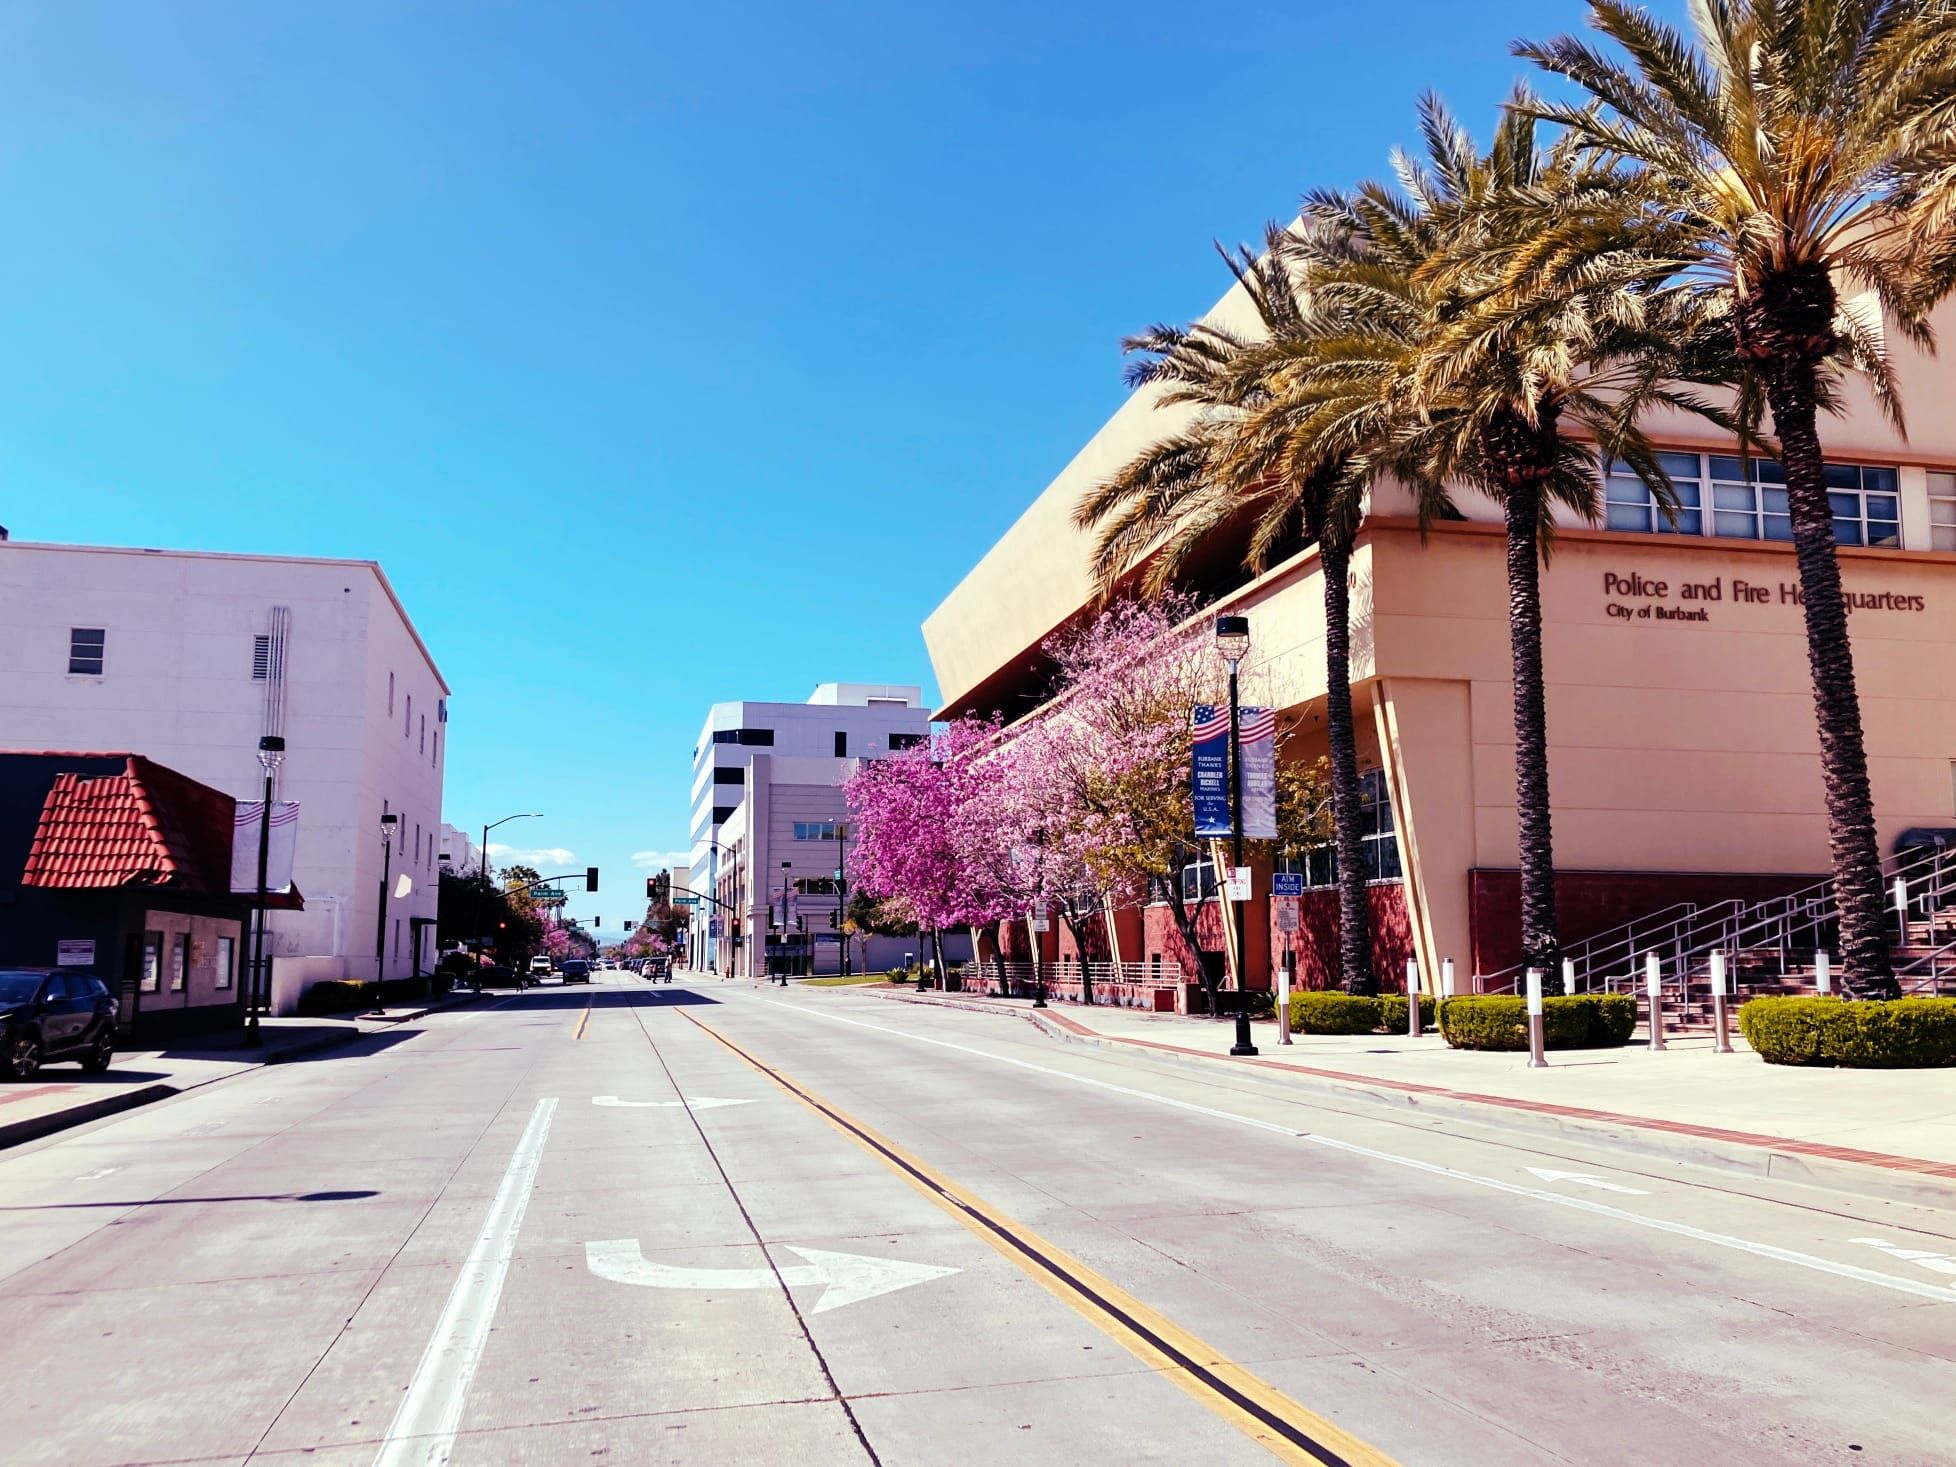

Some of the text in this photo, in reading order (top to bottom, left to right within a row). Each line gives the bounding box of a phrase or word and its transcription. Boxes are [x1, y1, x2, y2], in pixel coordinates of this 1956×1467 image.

[1604, 572, 1925, 615] Police and Fire Hequarters
[1606, 603, 1709, 623] City of Burbank
[1281, 875, 1295, 883] ATM
[1275, 883, 1300, 891] INSIDE
